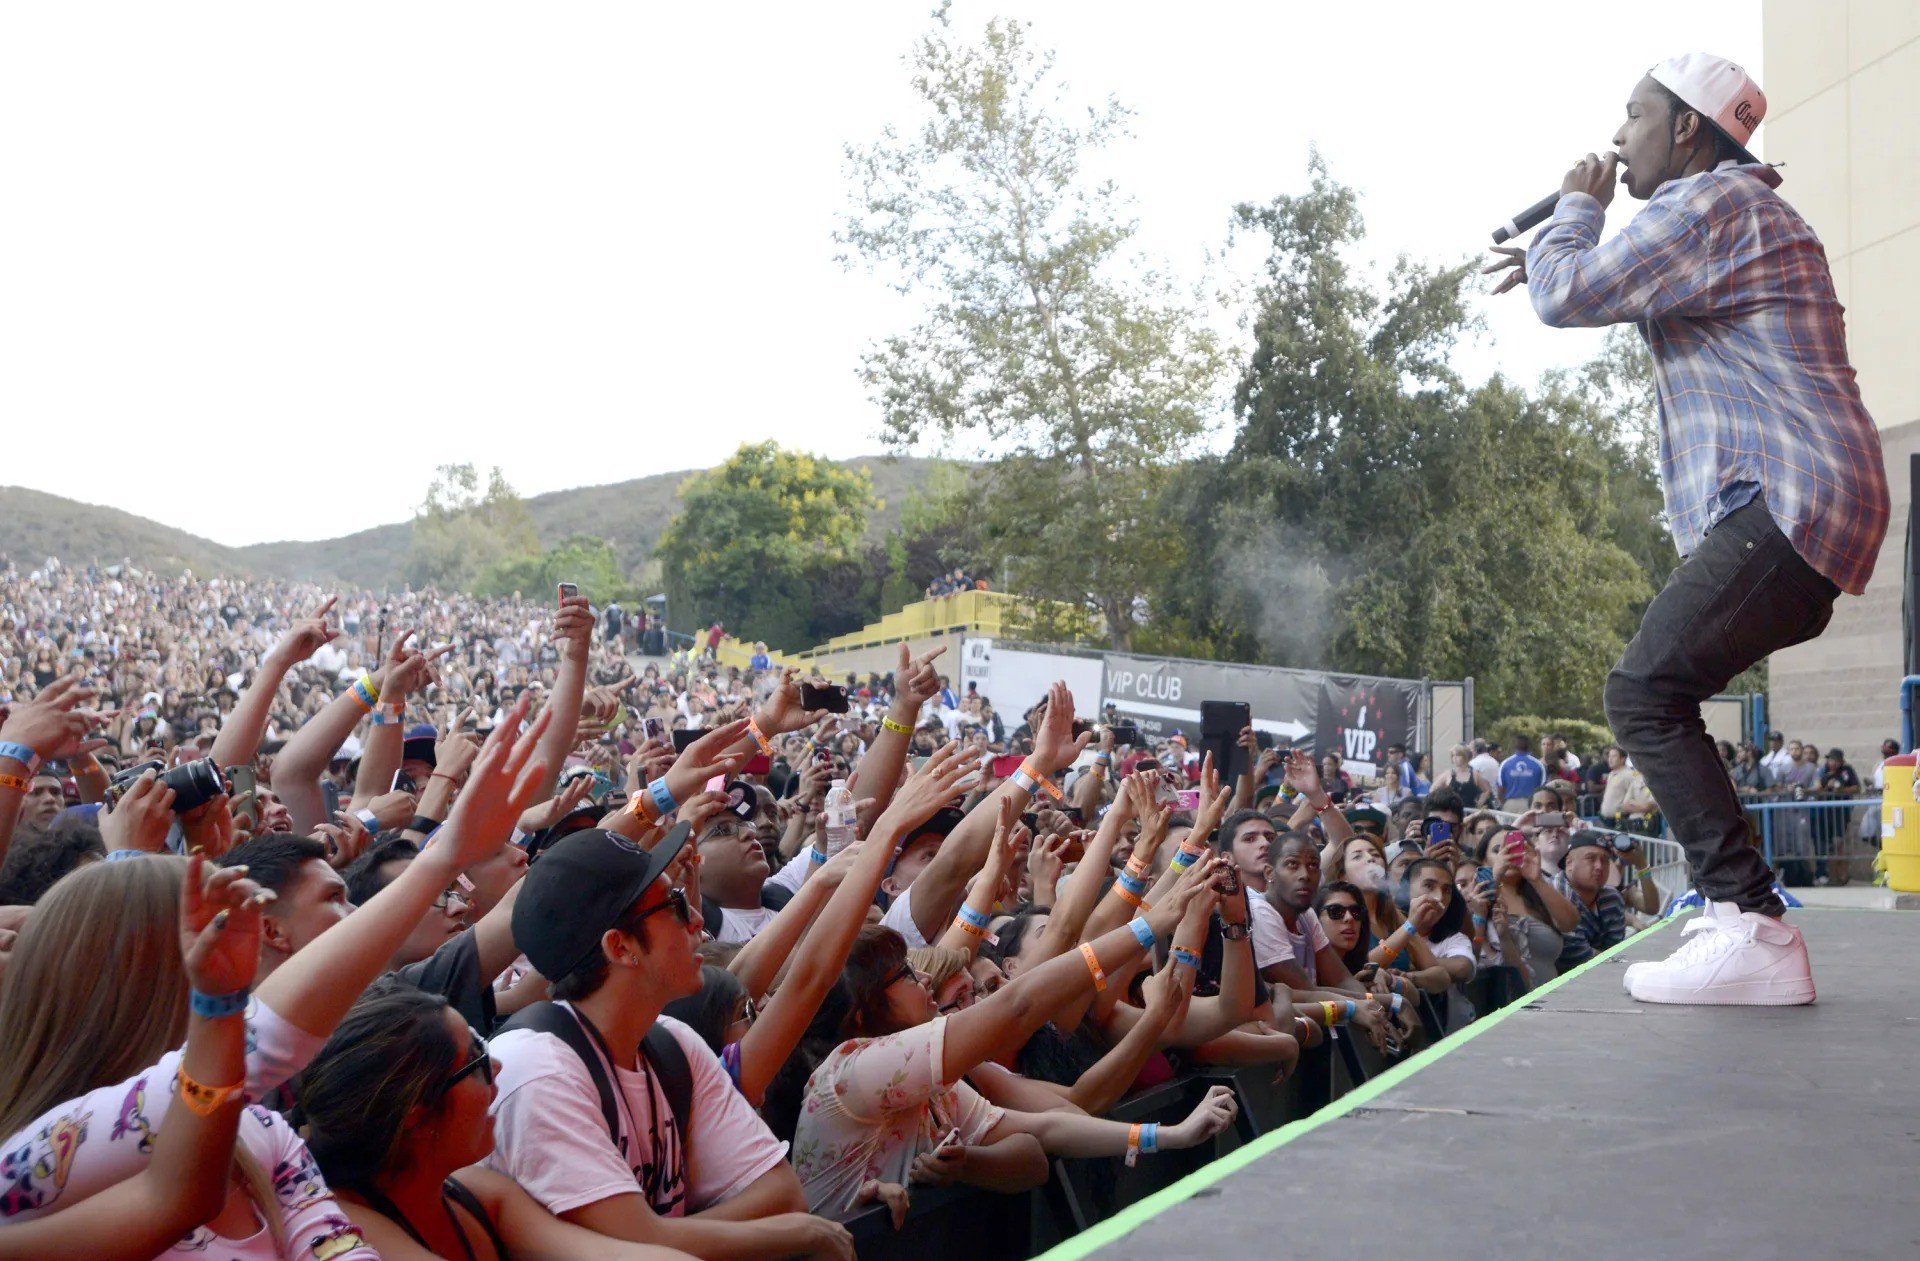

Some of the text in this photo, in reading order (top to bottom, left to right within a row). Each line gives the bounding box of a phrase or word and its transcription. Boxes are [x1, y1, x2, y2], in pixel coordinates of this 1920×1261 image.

[1107, 669, 1182, 701] VIP CLUB
[1343, 728, 1377, 761] VIP
